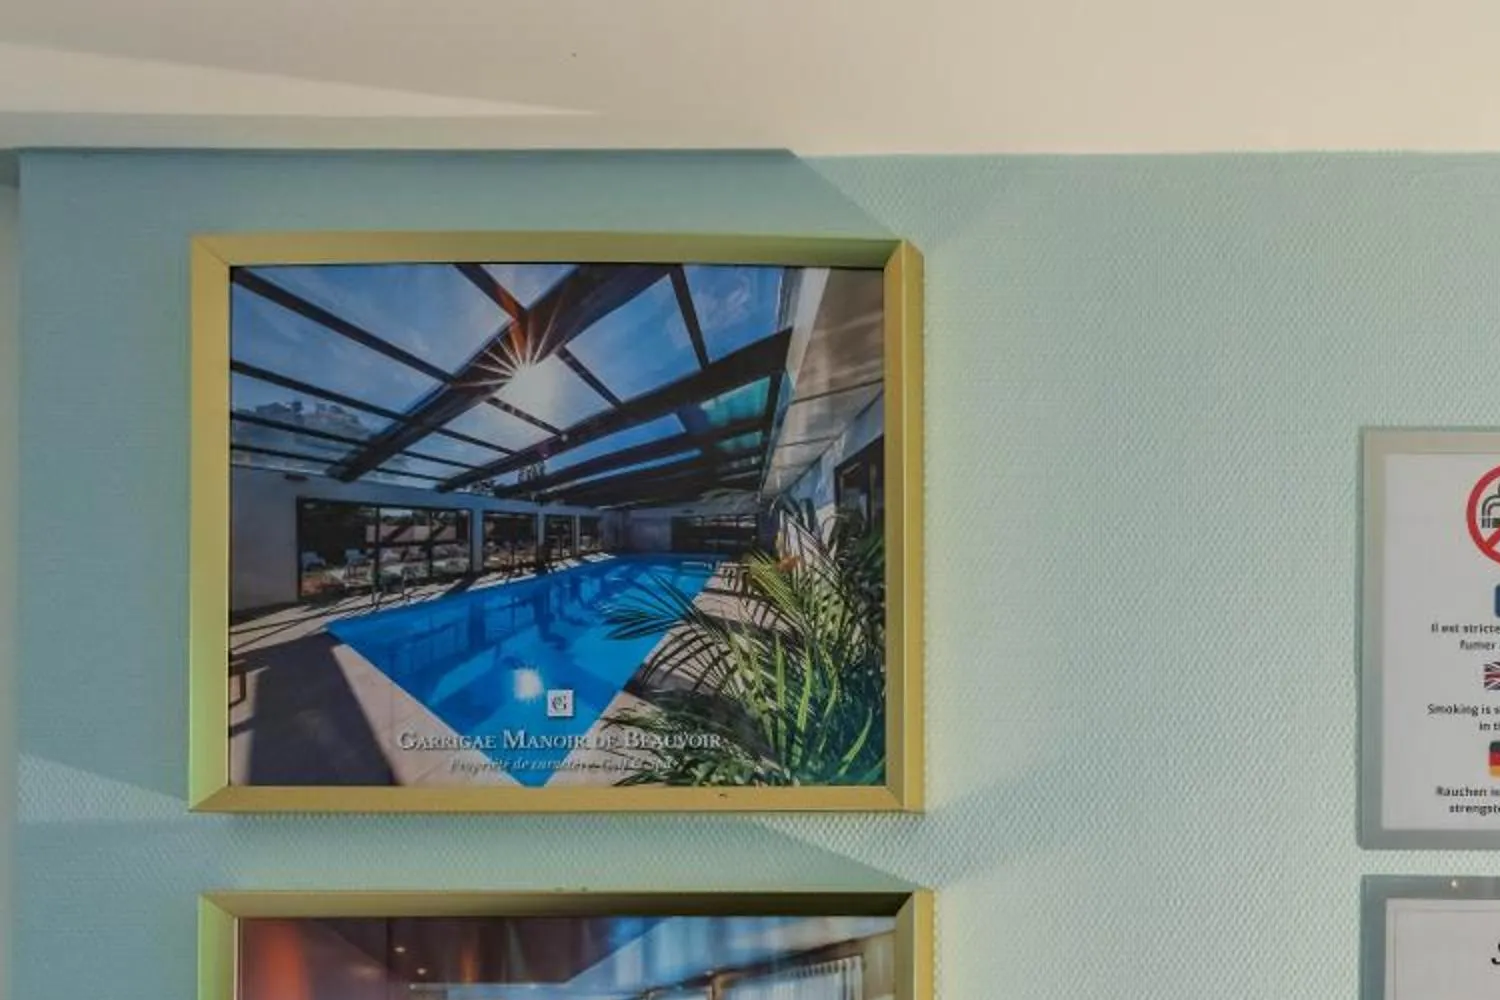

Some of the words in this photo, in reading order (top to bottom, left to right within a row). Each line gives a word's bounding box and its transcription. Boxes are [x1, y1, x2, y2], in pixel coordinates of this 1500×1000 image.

[1441, 625, 1460, 634] est
[1460, 640, 1495, 650] fumer
[1427, 703, 1478, 716] Smoking
[1481, 704, 1491, 715] is
[1479, 722, 1491, 731] in
[1435, 786, 1487, 798] Rauchen
